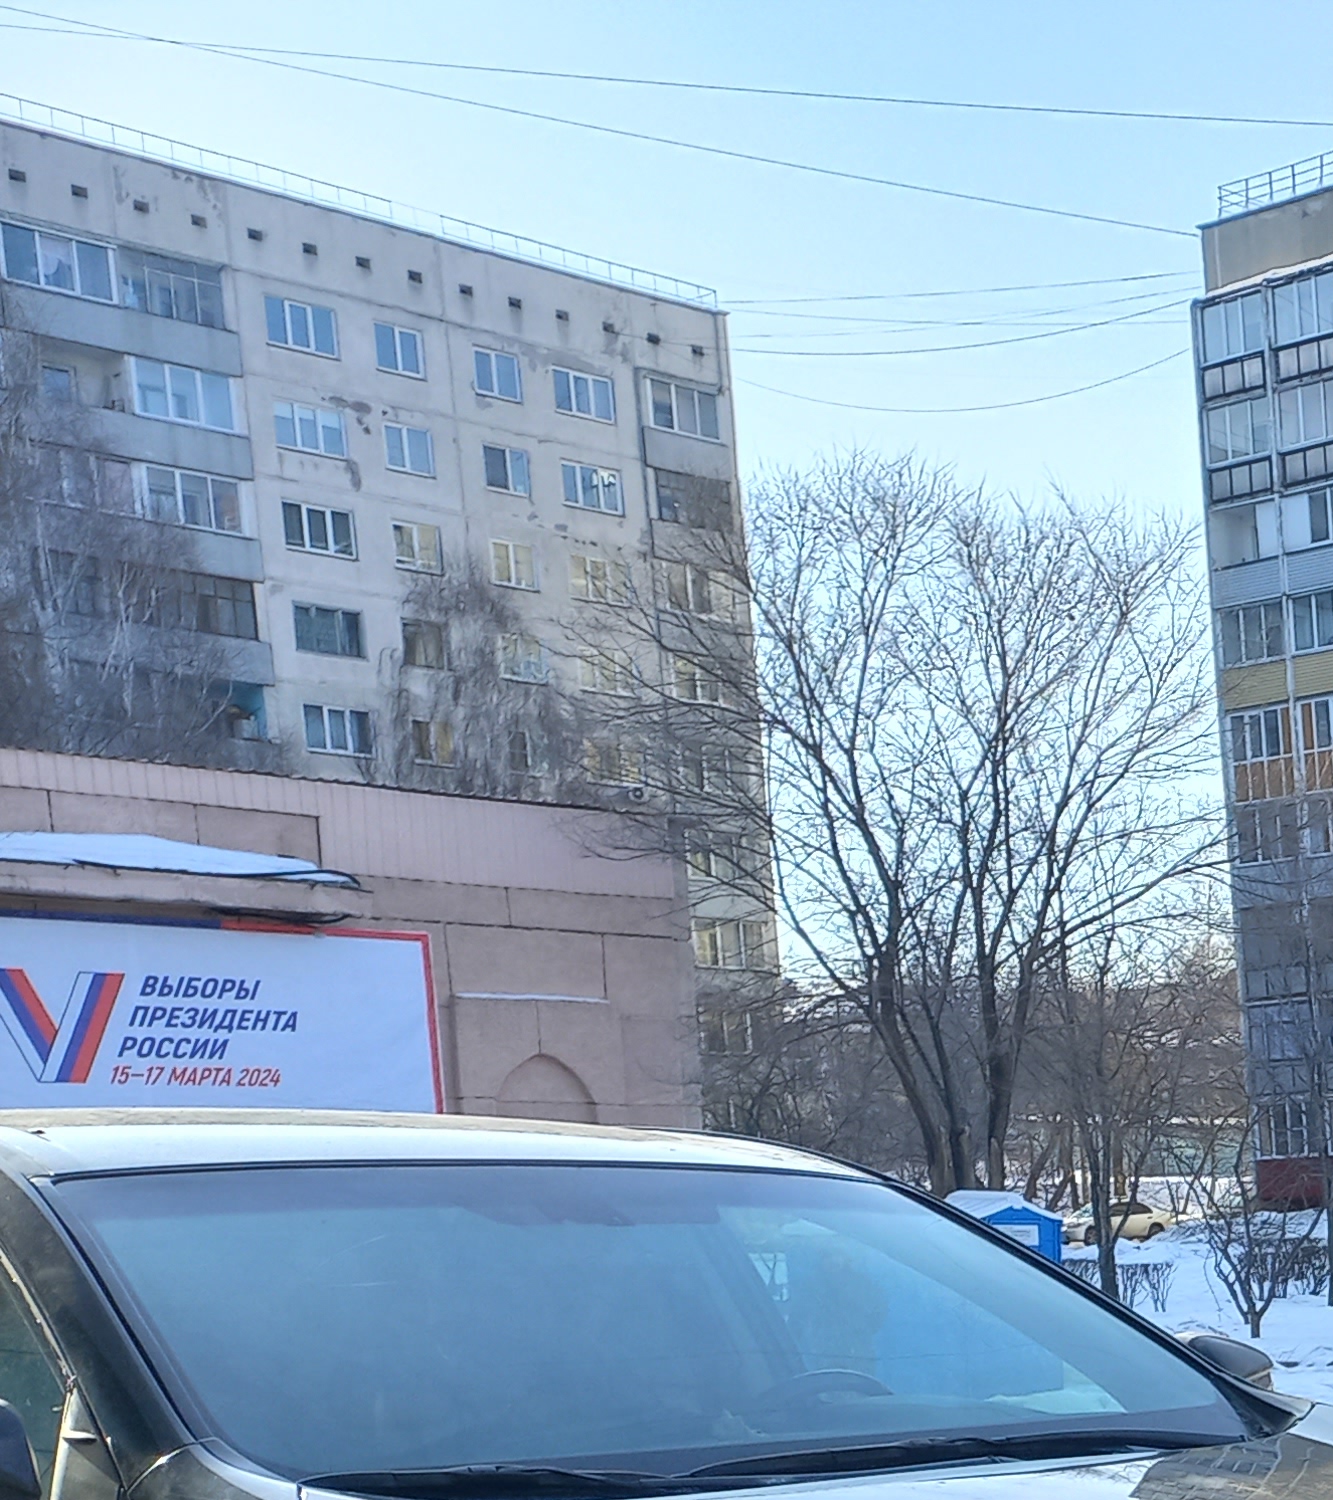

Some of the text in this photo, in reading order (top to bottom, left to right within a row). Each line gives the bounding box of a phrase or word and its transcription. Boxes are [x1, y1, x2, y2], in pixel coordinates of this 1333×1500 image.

[139, 975, 261, 1001] ВЫБОРЫ
[128, 1005, 299, 1034] ПРЕЗИДЕНТА
[117, 1036, 230, 1060] РОССИИ
[167, 1066, 232, 1086] МАРТА
[235, 1068, 281, 1087] 2024
